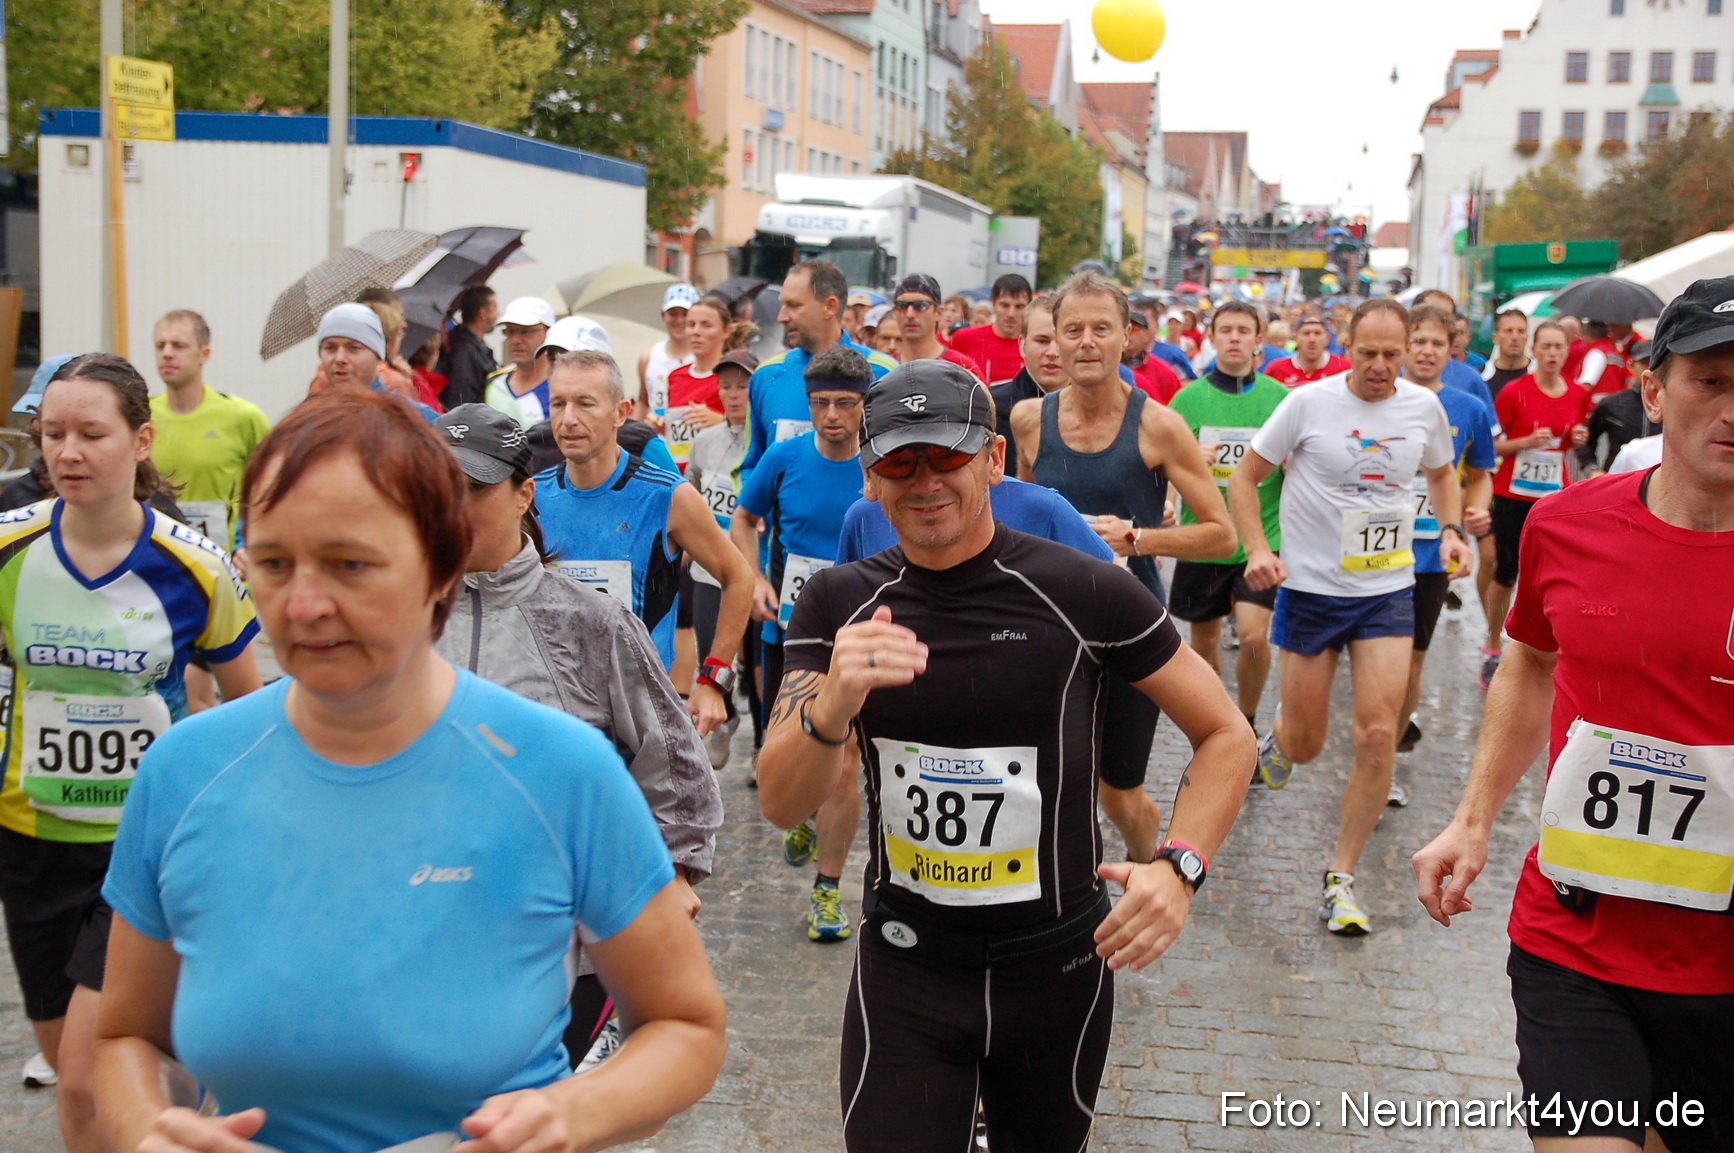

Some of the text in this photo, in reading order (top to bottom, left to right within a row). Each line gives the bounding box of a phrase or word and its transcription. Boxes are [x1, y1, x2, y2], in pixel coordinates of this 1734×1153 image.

[1359, 525, 1400, 552] 121
[31, 622, 107, 644] TEAM
[27, 644, 149, 674] BOCK
[66, 702, 126, 718] BOCK
[38, 727, 156, 775] 5093
[919, 755, 985, 776] BOCK
[1609, 740, 1688, 769] BOCK
[906, 784, 1005, 847] 387
[1582, 770, 1706, 842] 817
[914, 852, 993, 883] Richard
